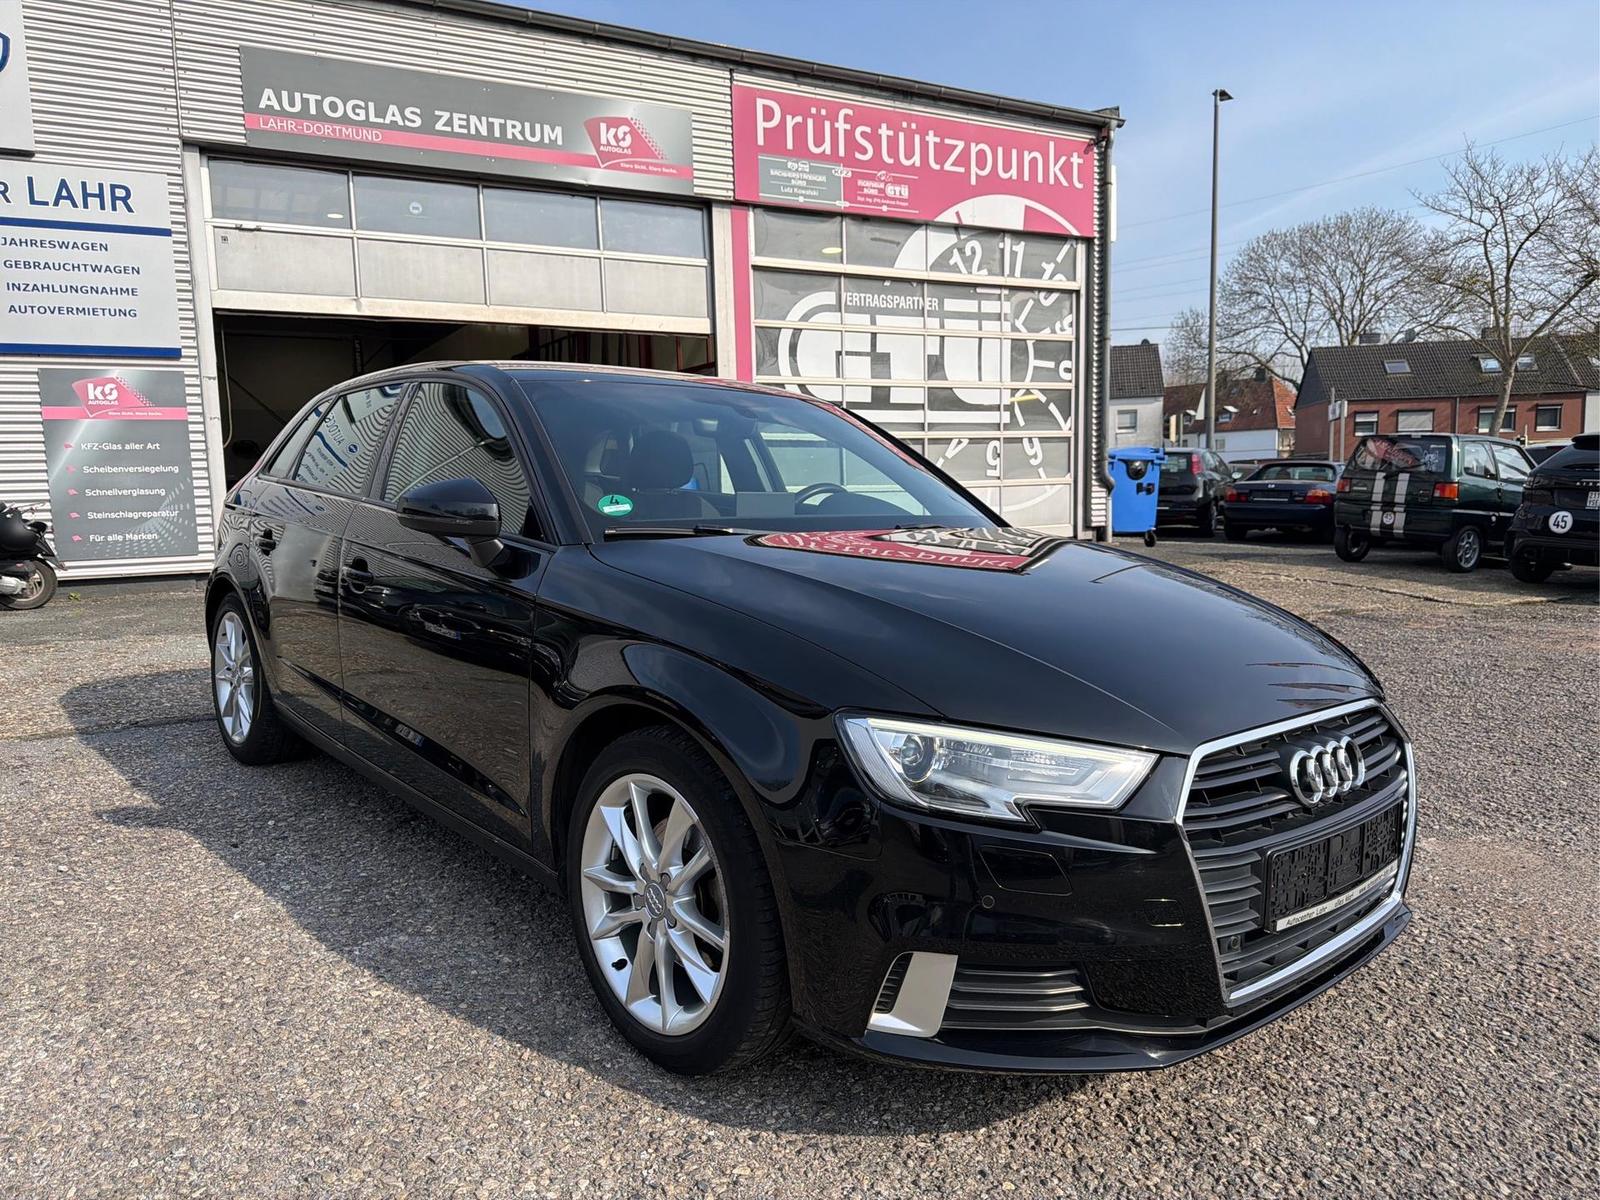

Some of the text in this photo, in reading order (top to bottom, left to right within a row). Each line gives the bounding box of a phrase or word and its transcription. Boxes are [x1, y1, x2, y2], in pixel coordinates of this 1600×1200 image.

[258, 88, 563, 146] AUTOGLAS ZENTRUM
[259, 116, 383, 142] LAHR-DORTMUND
[599, 145, 632, 155] AUTOGLAS
[755, 97, 1085, 189] Prüfstützpunkt
[26, 175, 135, 214] LAHR
[1, 236, 109, 252] JAHRESWAGEN
[3, 259, 141, 276] GEBRAUCHTWAGEN
[6, 281, 139, 297] INZAHLUNGNAHME
[8, 304, 137, 318] AUTOVERMIETUNG
[796, 298, 1011, 405] GTÜ
[81, 442, 160, 451] KFZ-Glas aller Art
[83, 465, 179, 475] Scheibenversiegelung
[85, 487, 166, 497] Schnellverglasung
[87, 509, 180, 520] Steinschlagreparatur
[1553, 514, 1569, 530] 45
[90, 532, 158, 542] Für alle Marken
